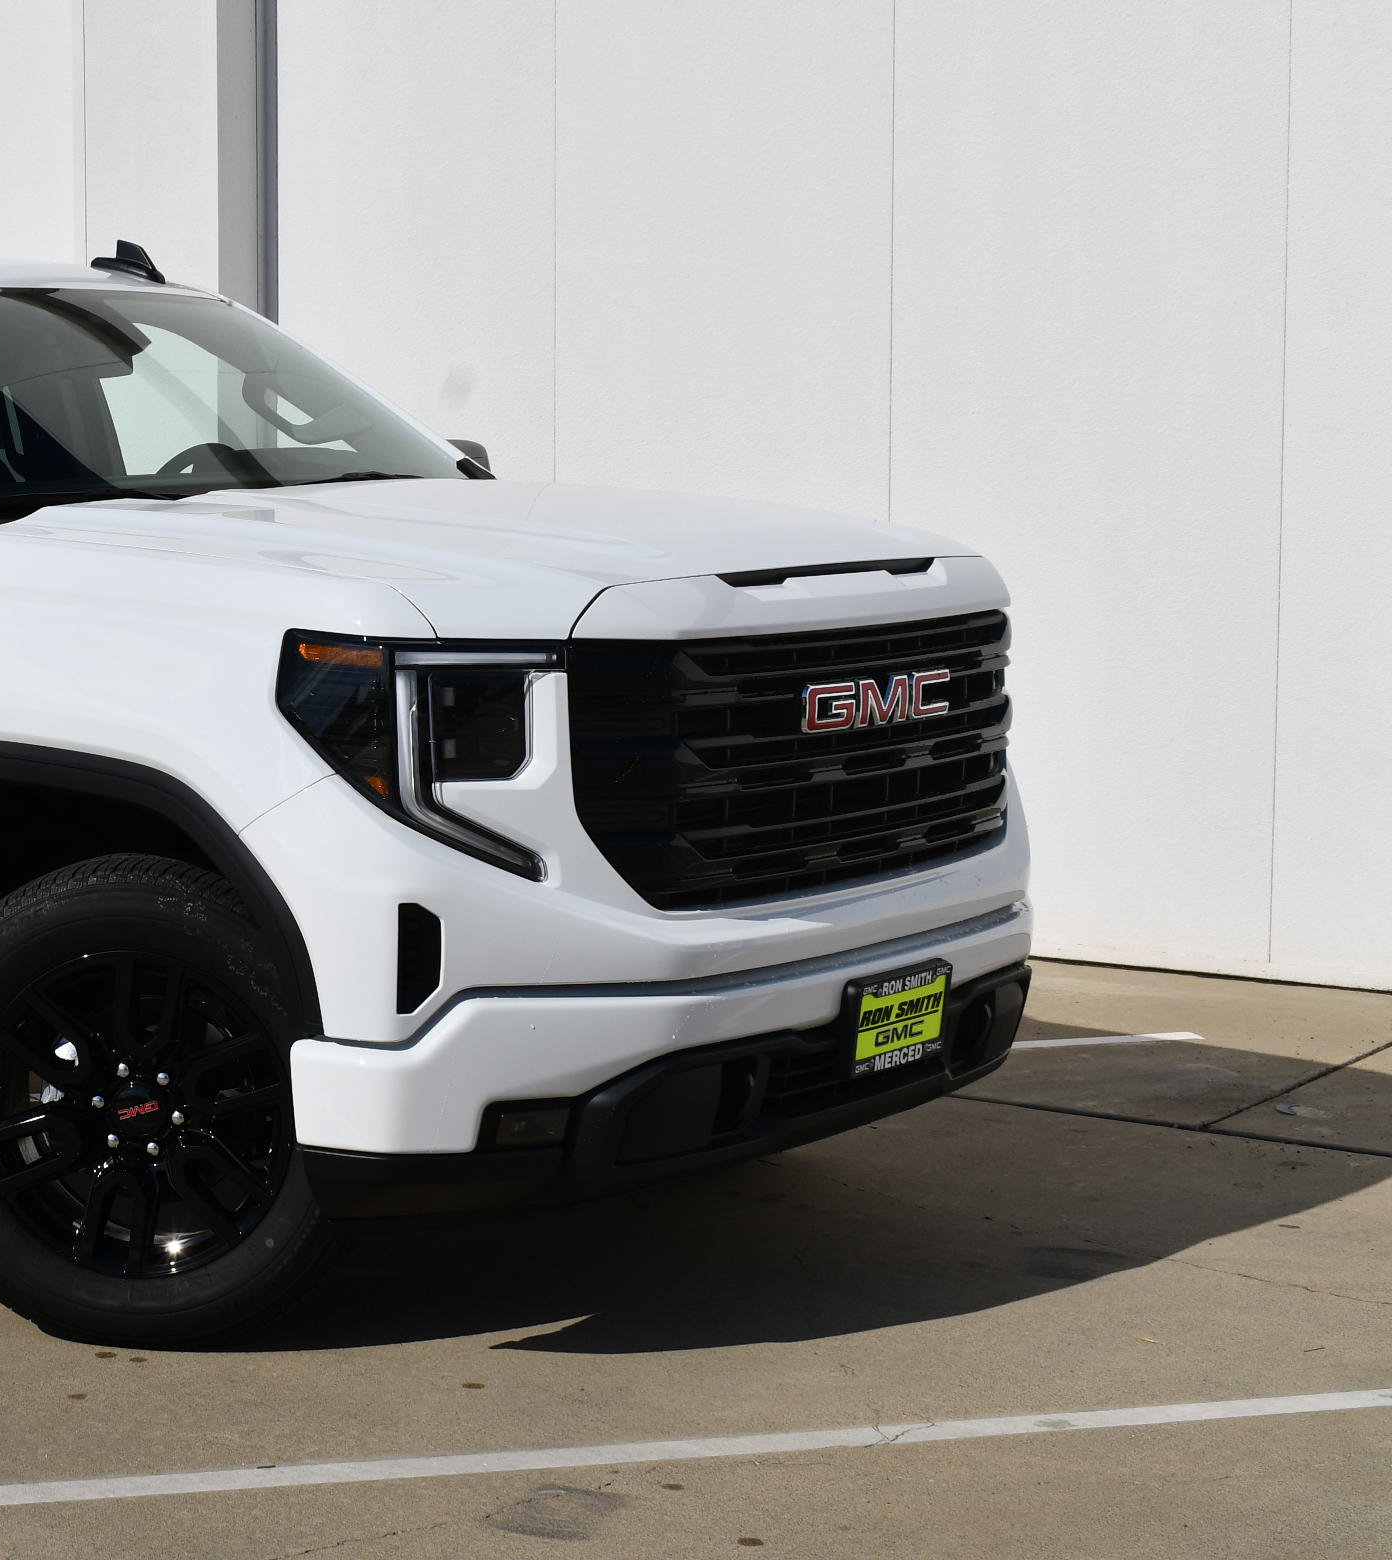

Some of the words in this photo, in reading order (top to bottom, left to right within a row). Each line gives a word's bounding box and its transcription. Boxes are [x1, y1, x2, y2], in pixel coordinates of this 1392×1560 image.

[802, 669, 950, 733] GMC
[881, 979, 903, 997] RON
[904, 970, 933, 991] SMITH
[859, 1003, 894, 1028] RON
[895, 991, 943, 1019] SMITH
[874, 1019, 926, 1047] GMC
[874, 1043, 923, 1072] MERCED
[118, 1101, 158, 1120] GMC
